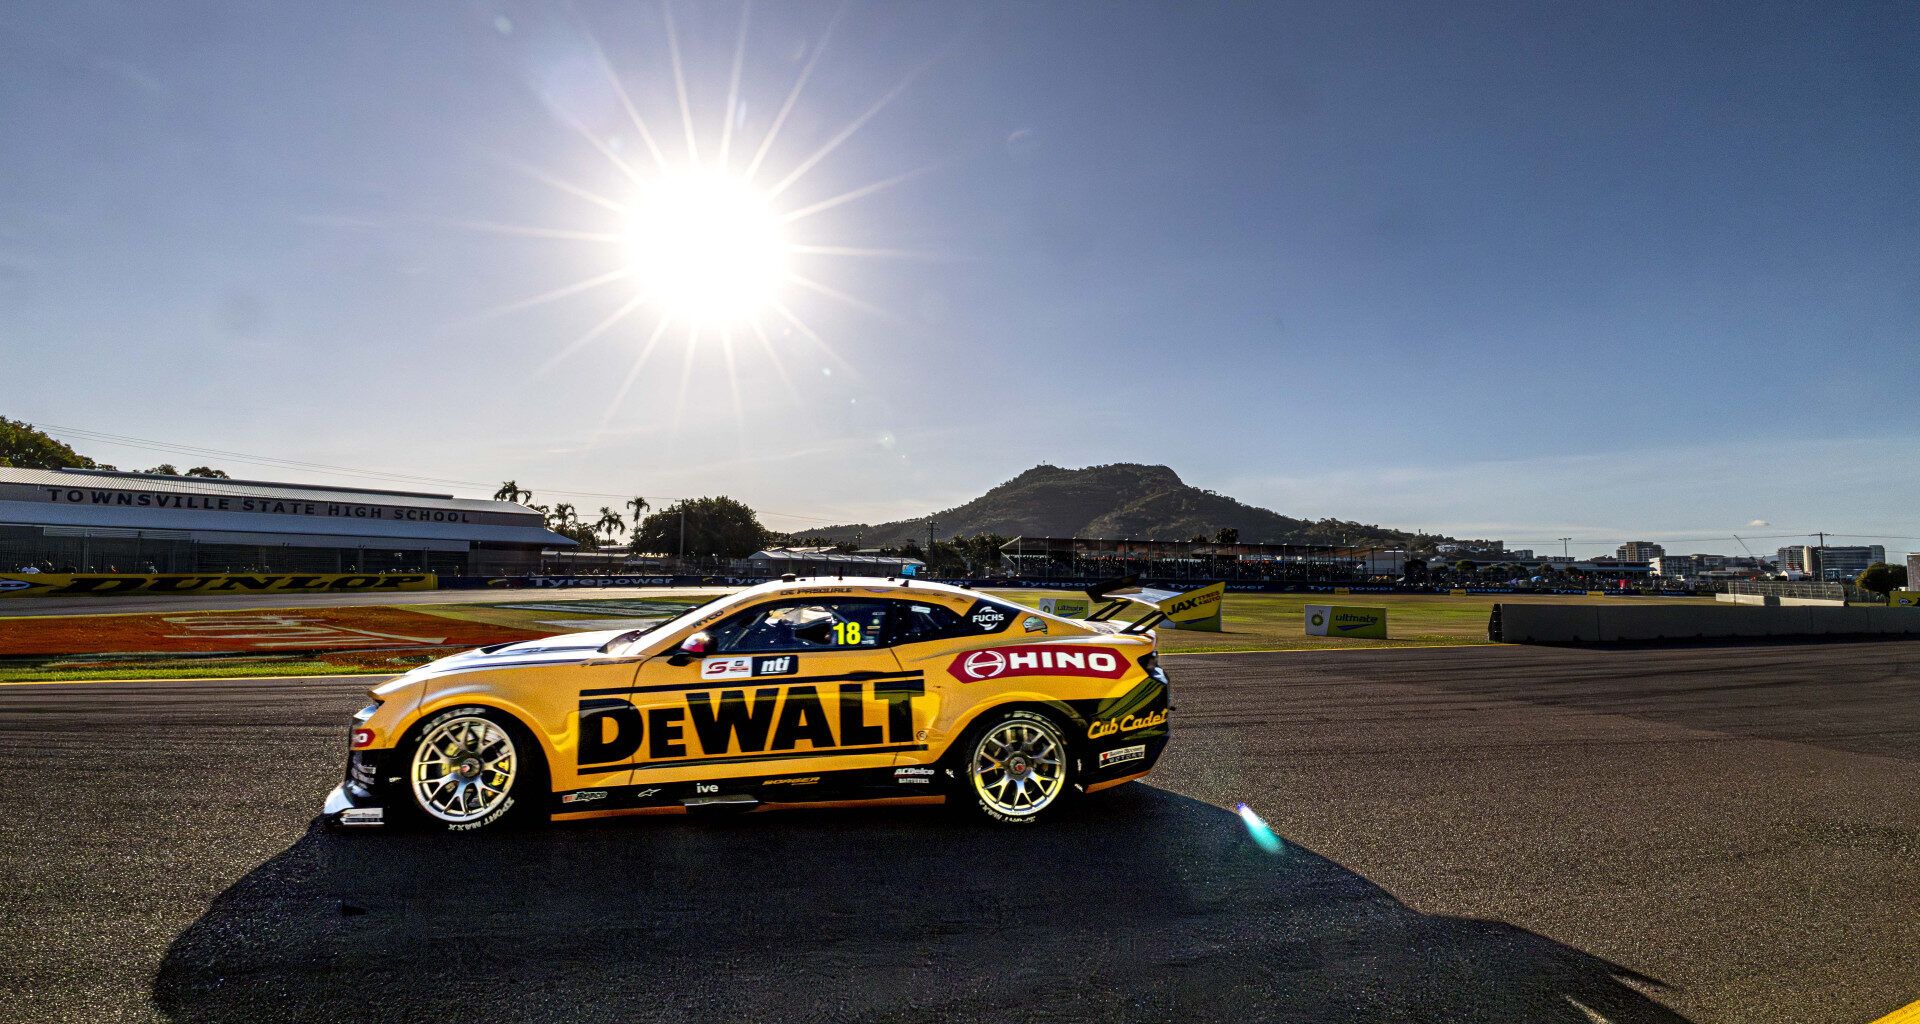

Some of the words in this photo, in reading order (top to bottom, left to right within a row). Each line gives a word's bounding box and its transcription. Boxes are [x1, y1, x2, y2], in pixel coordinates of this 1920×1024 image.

[47, 488, 230, 510] TOWNSVILLE
[242, 499, 315, 515] STATE
[328, 504, 382, 519] HIGH
[394, 509, 470, 523] SCHOOL
[48, 575, 427, 594] DUNLOP
[529, 578, 674, 588] Tyrepower
[1167, 597, 1199, 616] JAX
[972, 613, 1004, 622] FUCHS
[1335, 613, 1379, 624] ultimate
[833, 622, 861, 645] 18
[761, 657, 790, 672] nti
[1009, 651, 1117, 672] HINO
[1087, 717, 1119, 739] Cub
[1120, 708, 1168, 732] Cadet
